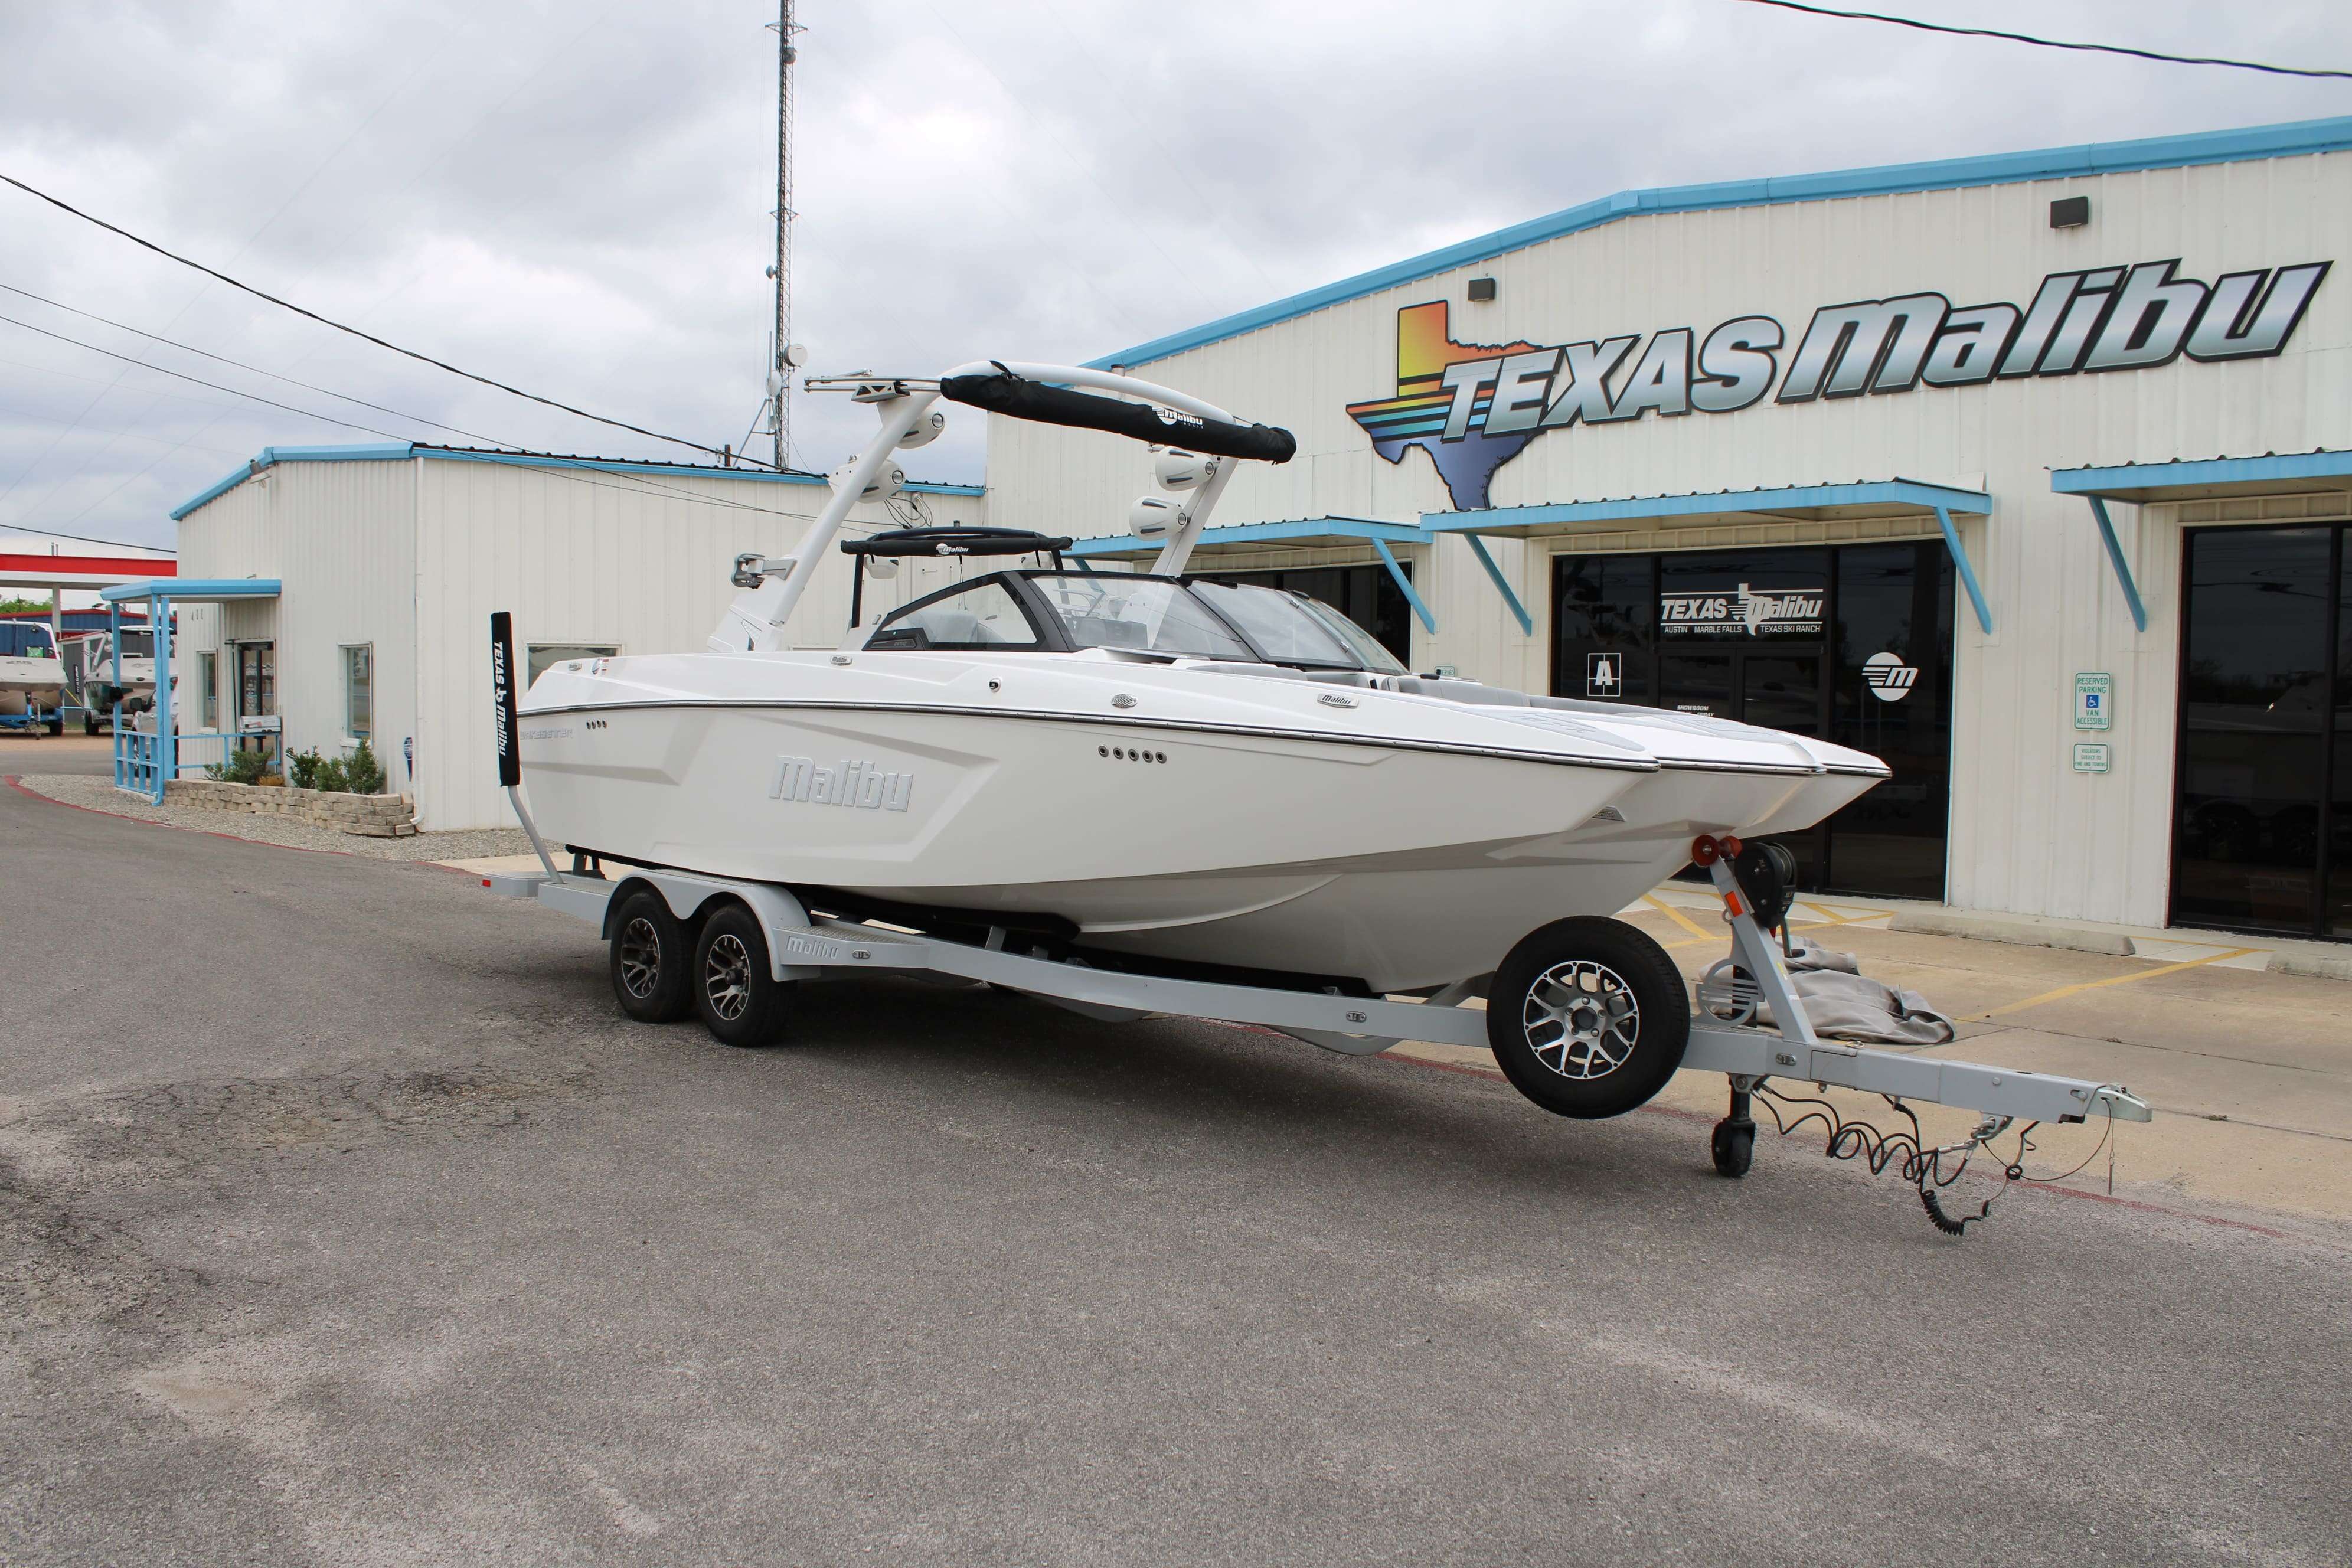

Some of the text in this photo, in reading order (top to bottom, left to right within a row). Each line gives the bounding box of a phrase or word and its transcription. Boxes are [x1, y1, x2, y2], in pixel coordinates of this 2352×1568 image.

[1440, 257, 2334, 444] TEXAS Malibu
[1164, 409, 1203, 425] Malibu
[1661, 595, 1823, 620] TEXAS Malibu
[1721, 625, 1742, 633] FALLS
[1760, 625, 1782, 633] TEXAS
[1783, 625, 1795, 633] SKI
[1796, 625, 1821, 633] RANCH
[1595, 661, 1613, 685] A
[494, 641, 508, 756] TEXAS Malibu
[1322, 695, 1351, 705] Malibu
[2076, 717, 2108, 726] ACCESSIBLE
[769, 755, 914, 812] Malibu
[786, 936, 838, 959] Malibu
